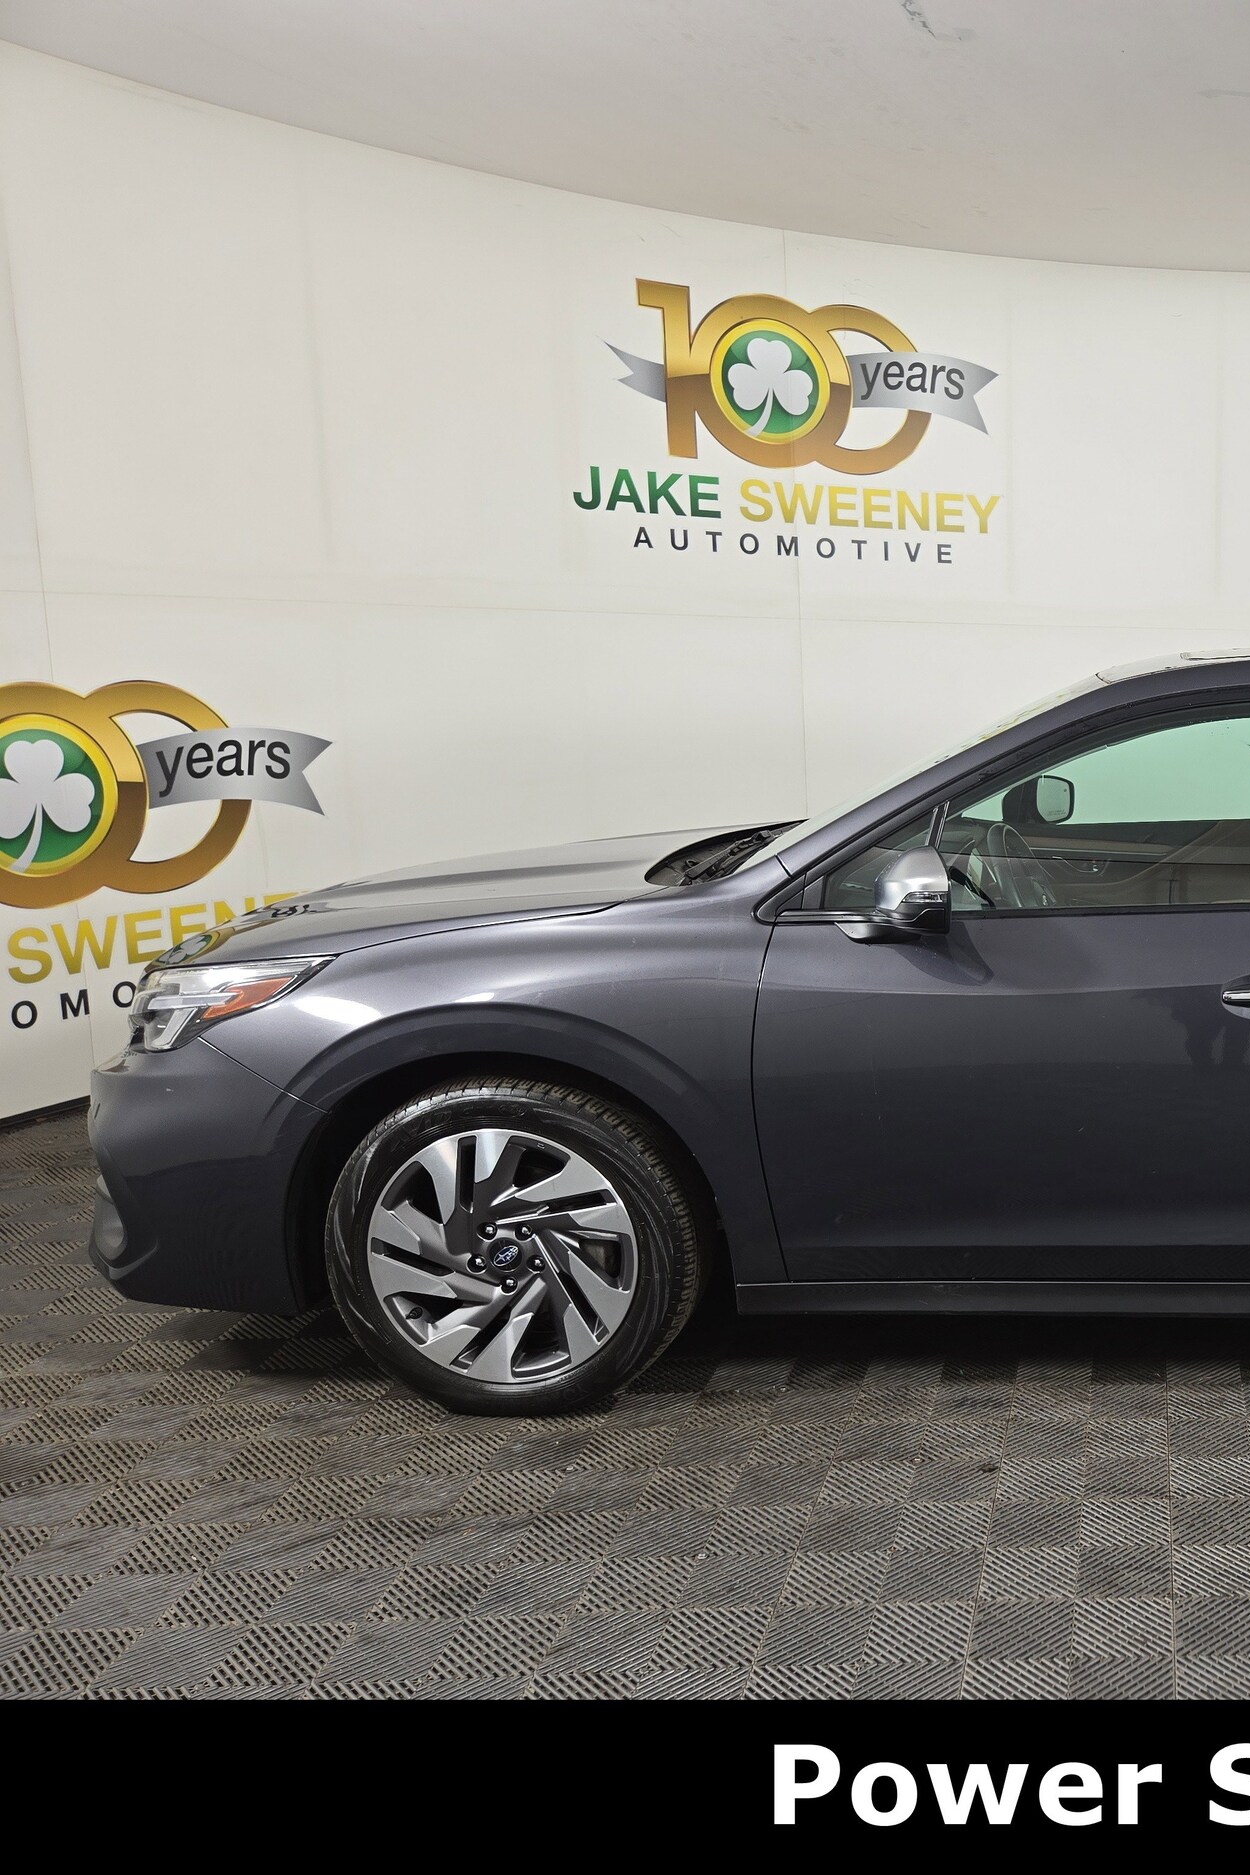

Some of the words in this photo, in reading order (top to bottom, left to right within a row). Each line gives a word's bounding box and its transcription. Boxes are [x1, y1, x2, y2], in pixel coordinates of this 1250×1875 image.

[636, 277, 932, 475] 100
[860, 360, 965, 400] years
[573, 465, 722, 519] JAKE
[739, 479, 1000, 534] SWEENEY
[633, 526, 953, 564] AUTOMOTIVE
[155, 739, 291, 798] years
